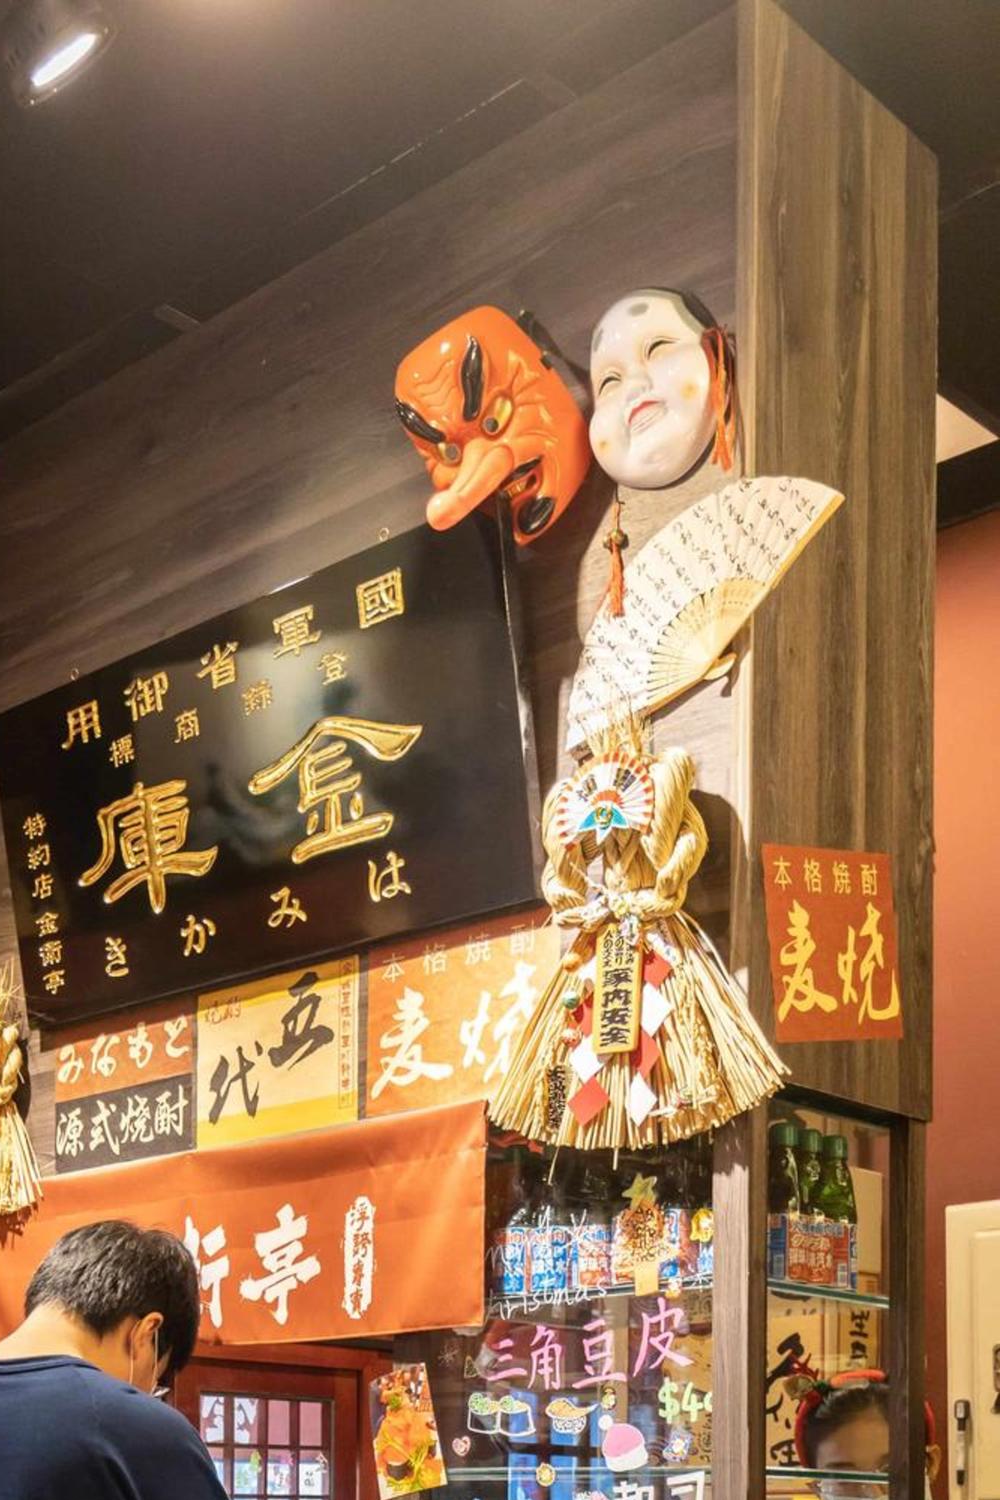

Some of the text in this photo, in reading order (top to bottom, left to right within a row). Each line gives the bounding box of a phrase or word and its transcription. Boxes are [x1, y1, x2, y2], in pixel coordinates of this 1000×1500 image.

[772, 856, 878, 896] 本格焼酎
[105, 852, 411, 979] はみかき
[57, 1014, 190, 1084] みなもと
[56, 1084, 189, 1158] 源式焼酎
[486, 1297, 694, 1390] 三角豆皮
